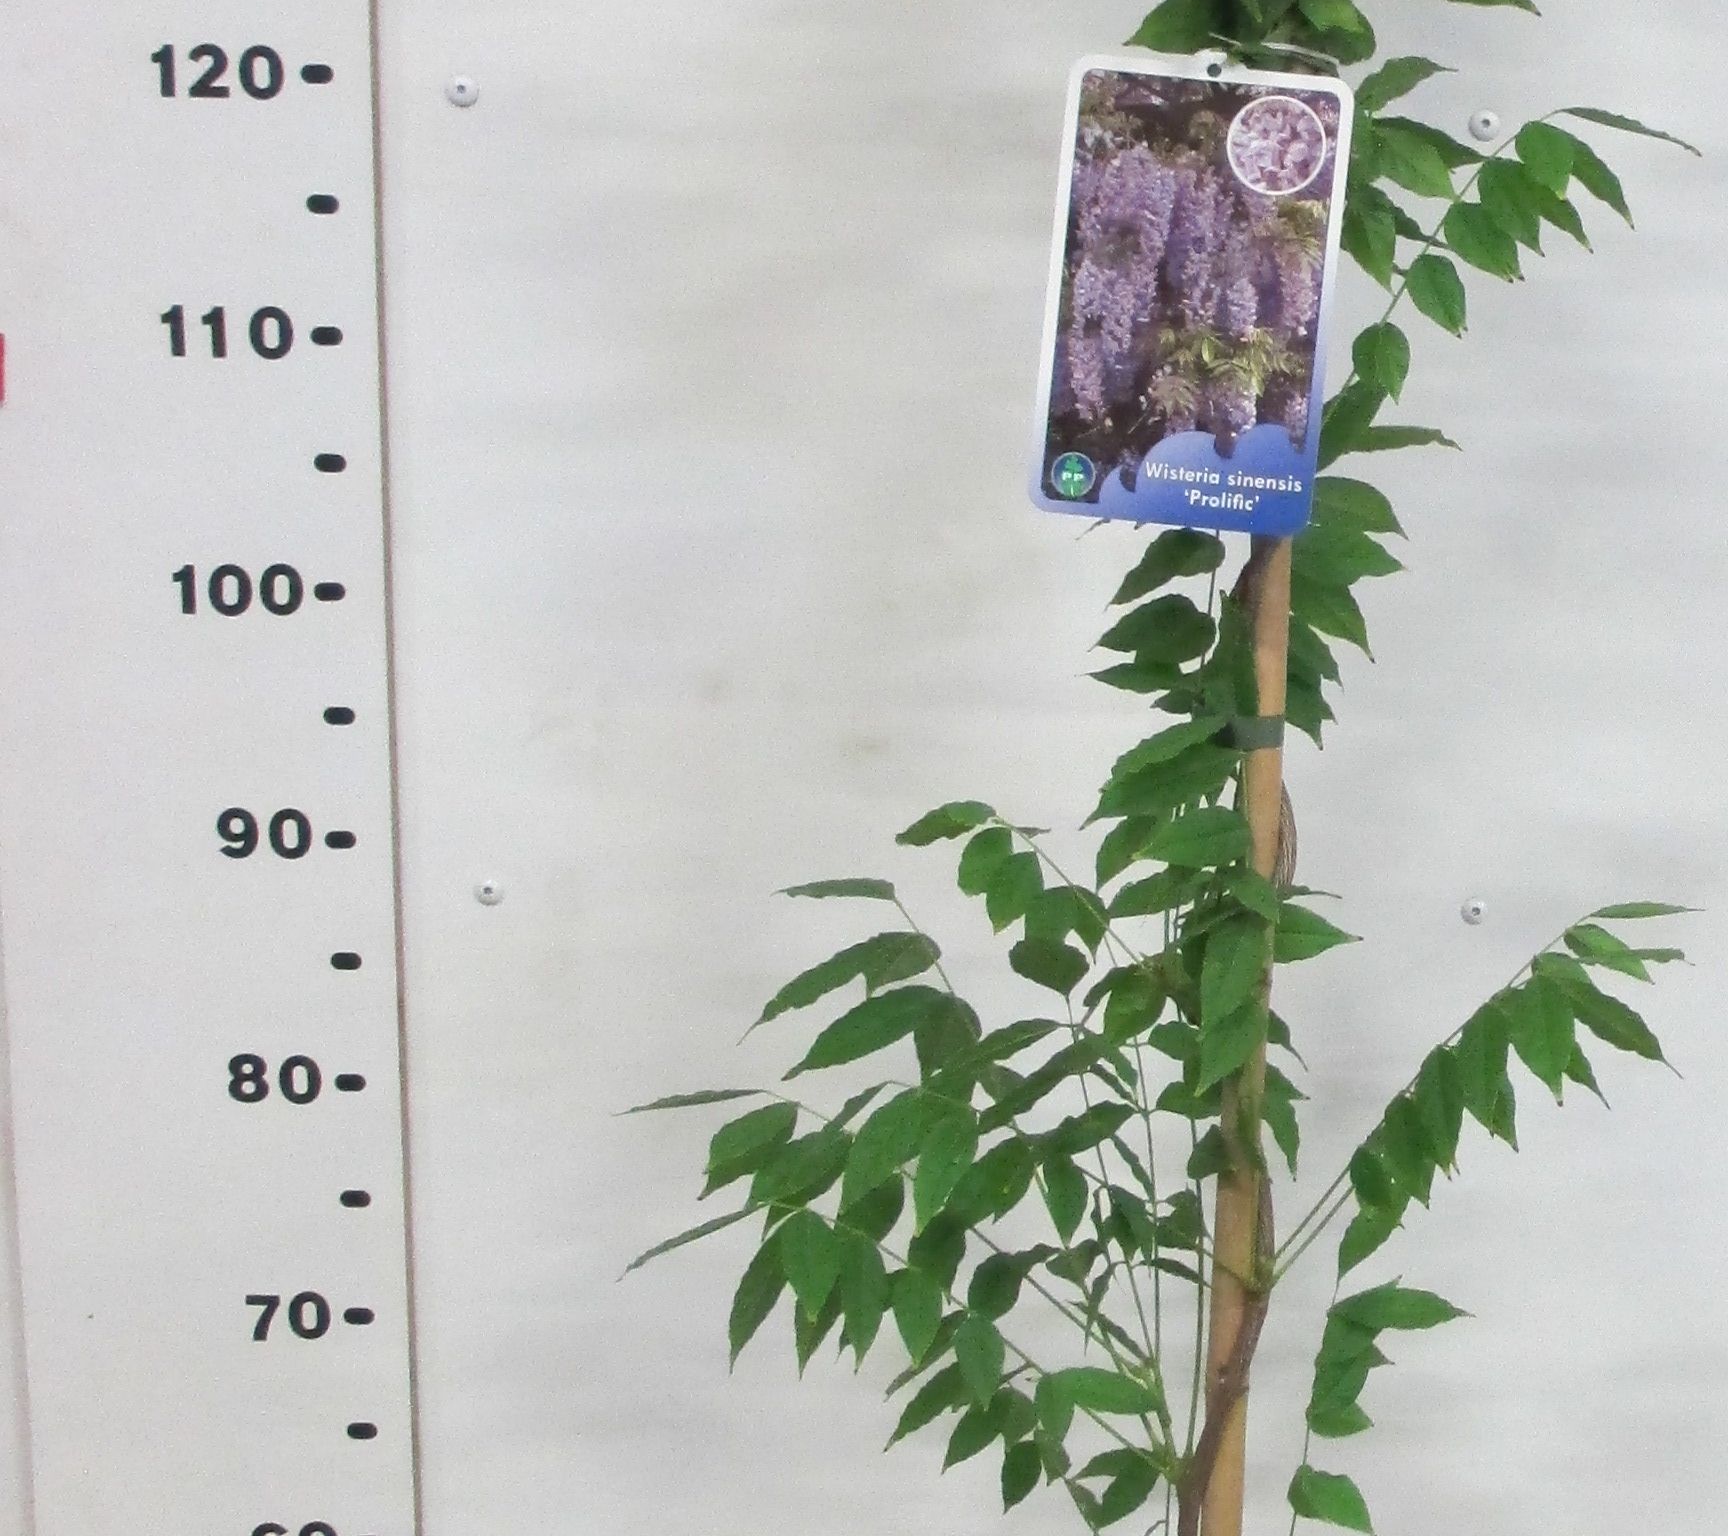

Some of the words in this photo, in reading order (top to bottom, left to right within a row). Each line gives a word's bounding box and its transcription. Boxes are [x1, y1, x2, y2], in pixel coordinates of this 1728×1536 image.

[149, 42, 285, 101] 120
[159, 304, 295, 361] 110
[1145, 462, 1221, 485] Wisteria
[1227, 470, 1303, 493] sinensis
[170, 562, 305, 618] 100
[214, 806, 313, 861] 90
[226, 1052, 323, 1106] 80
[243, 1290, 332, 1342] 70
